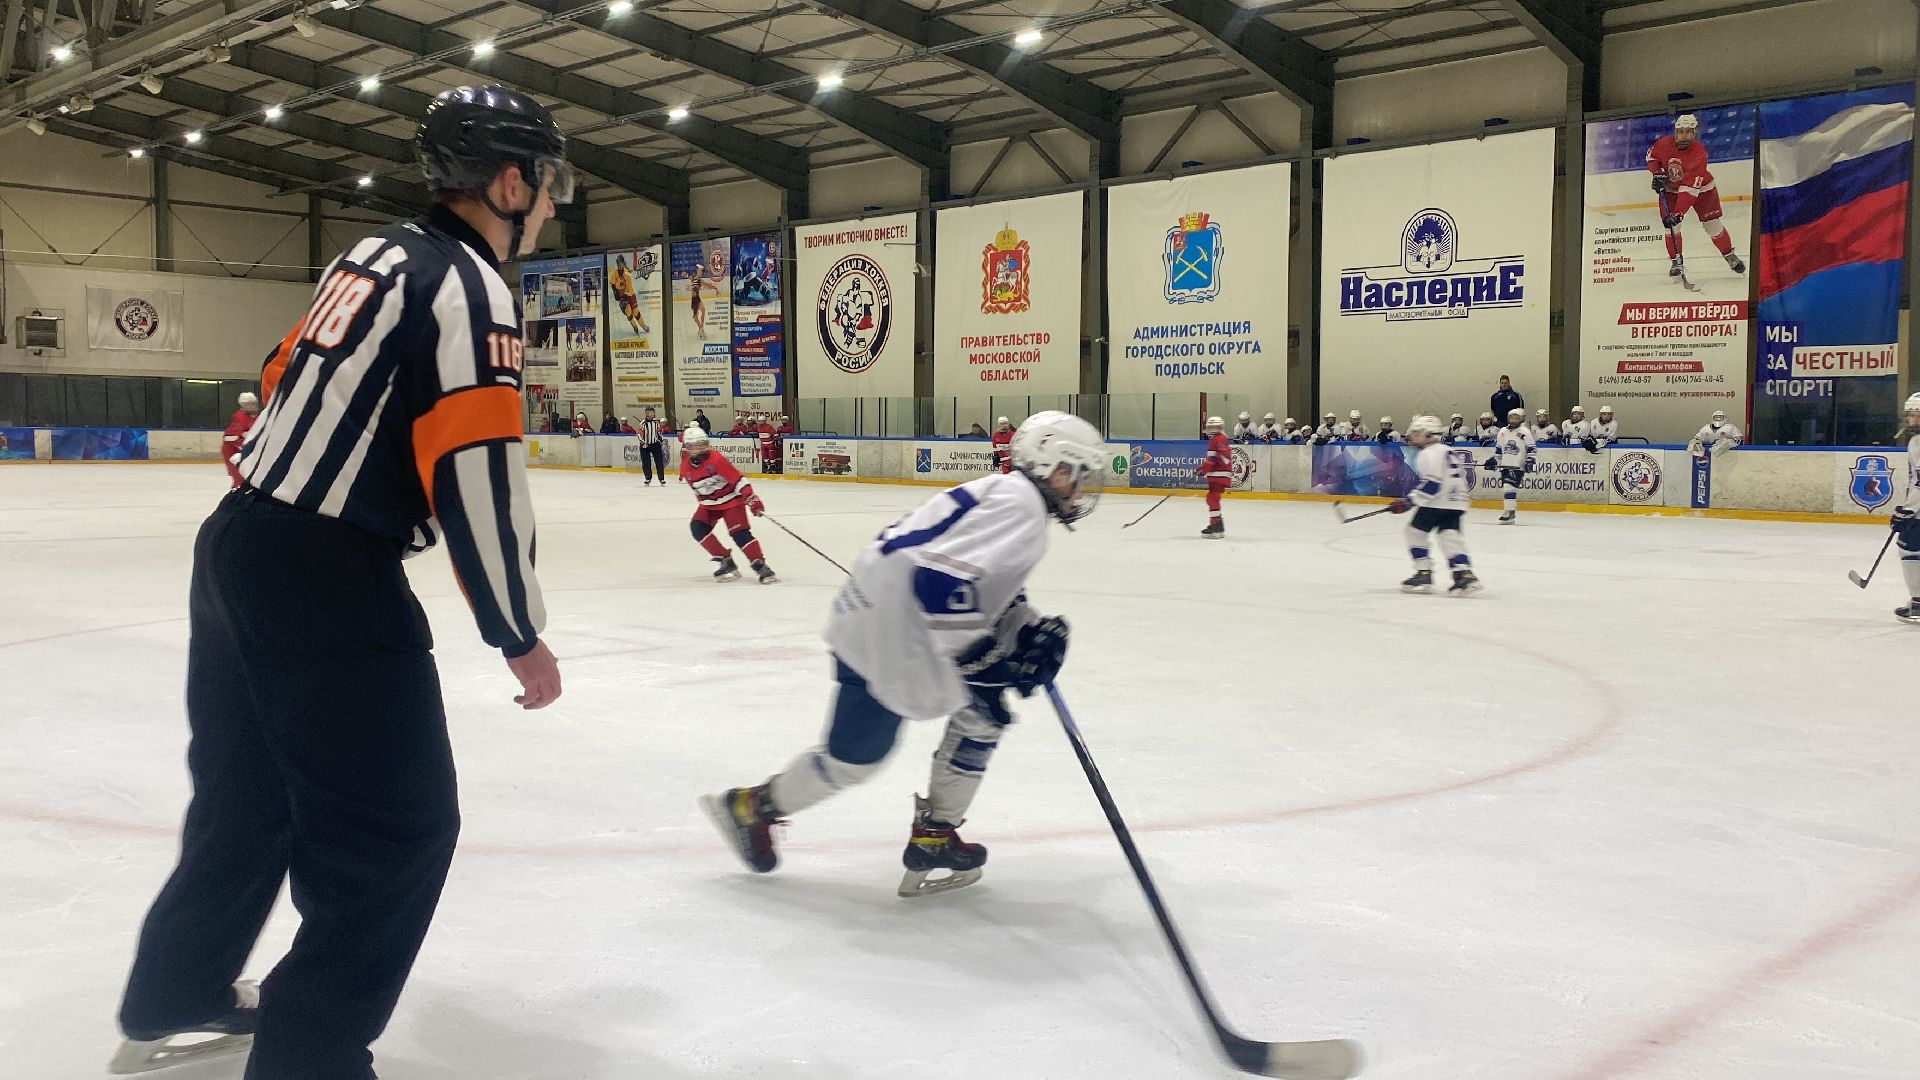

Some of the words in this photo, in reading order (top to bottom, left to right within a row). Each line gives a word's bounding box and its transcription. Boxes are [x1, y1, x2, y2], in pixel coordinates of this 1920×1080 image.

[804, 234, 834, 249] ТВОРИМ
[835, 229, 873, 246] ИСТОРИЮ
[874, 225, 908, 241] ВМЕСТЕ!
[820, 260, 862, 310] ФЕДЕРАЦИЯ
[865, 262, 888, 306] ХОККЕЯ
[302, 269, 376, 350] 118
[1626, 308, 1646, 321] МЫ
[1648, 306, 1688, 320] ВЕРИМ
[1692, 303, 1738, 320] ТВЁРДО
[1133, 320, 1252, 340] АДМИНИСТРАЦИЯ
[1632, 326, 1639, 338] В
[1642, 325, 1683, 338] ГЕРОЕВ
[1686, 324, 1738, 337] СПОРТА!
[1766, 325, 1798, 344] МЫ
[960, 332, 1050, 348] ПРАВИТЕЛЬСТВО
[486, 332, 523, 374] 118
[834, 349, 872, 368] РОССИИ
[969, 348, 1040, 365] МОСКОВСКОЙ
[1125, 342, 1206, 360] ГОРОДСКОГО
[1208, 339, 1262, 356] ОКРУГА
[1766, 353, 1788, 370] ЗА
[1795, 345, 1895, 370] ЧЕСТНЫЙ
[980, 368, 1029, 382] ОБЛАСТИ
[1154, 361, 1226, 379] ПОДОЛЬСК
[1624, 362, 1663, 370] Контактный
[1766, 379, 1833, 398] СПОРТ!
[1154, 456, 1187, 467] крокус
[1554, 462, 1596, 474] ХОККЕЯ
[1136, 467, 1207, 481] океанари
[1554, 480, 1604, 492] ОБЛАСТИ
[1698, 470, 1706, 504] PEPSI
